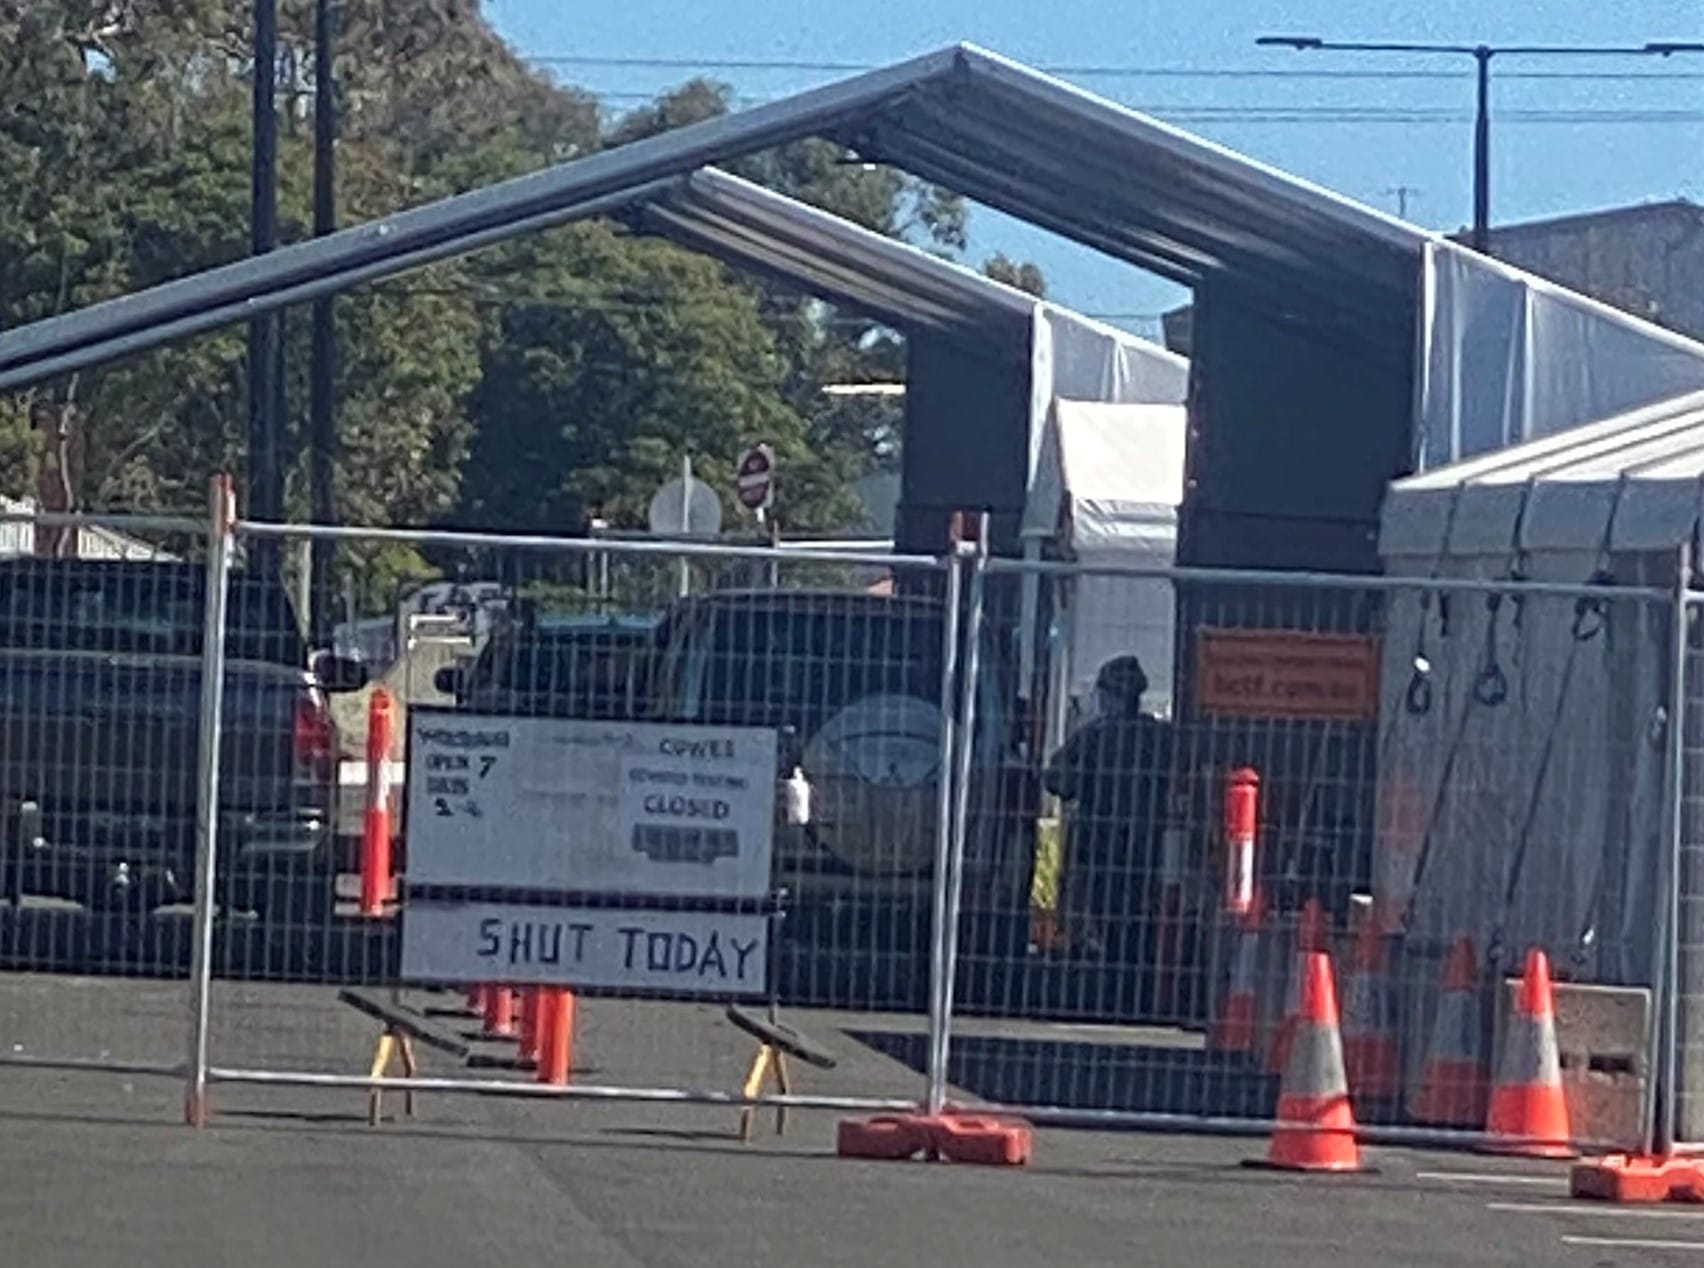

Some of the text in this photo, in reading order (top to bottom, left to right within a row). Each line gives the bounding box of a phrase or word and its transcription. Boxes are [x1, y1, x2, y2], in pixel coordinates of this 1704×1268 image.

[480, 756, 496, 779] 7
[644, 795, 730, 820] CLOSED
[476, 918, 758, 980] SHUT TODAY
